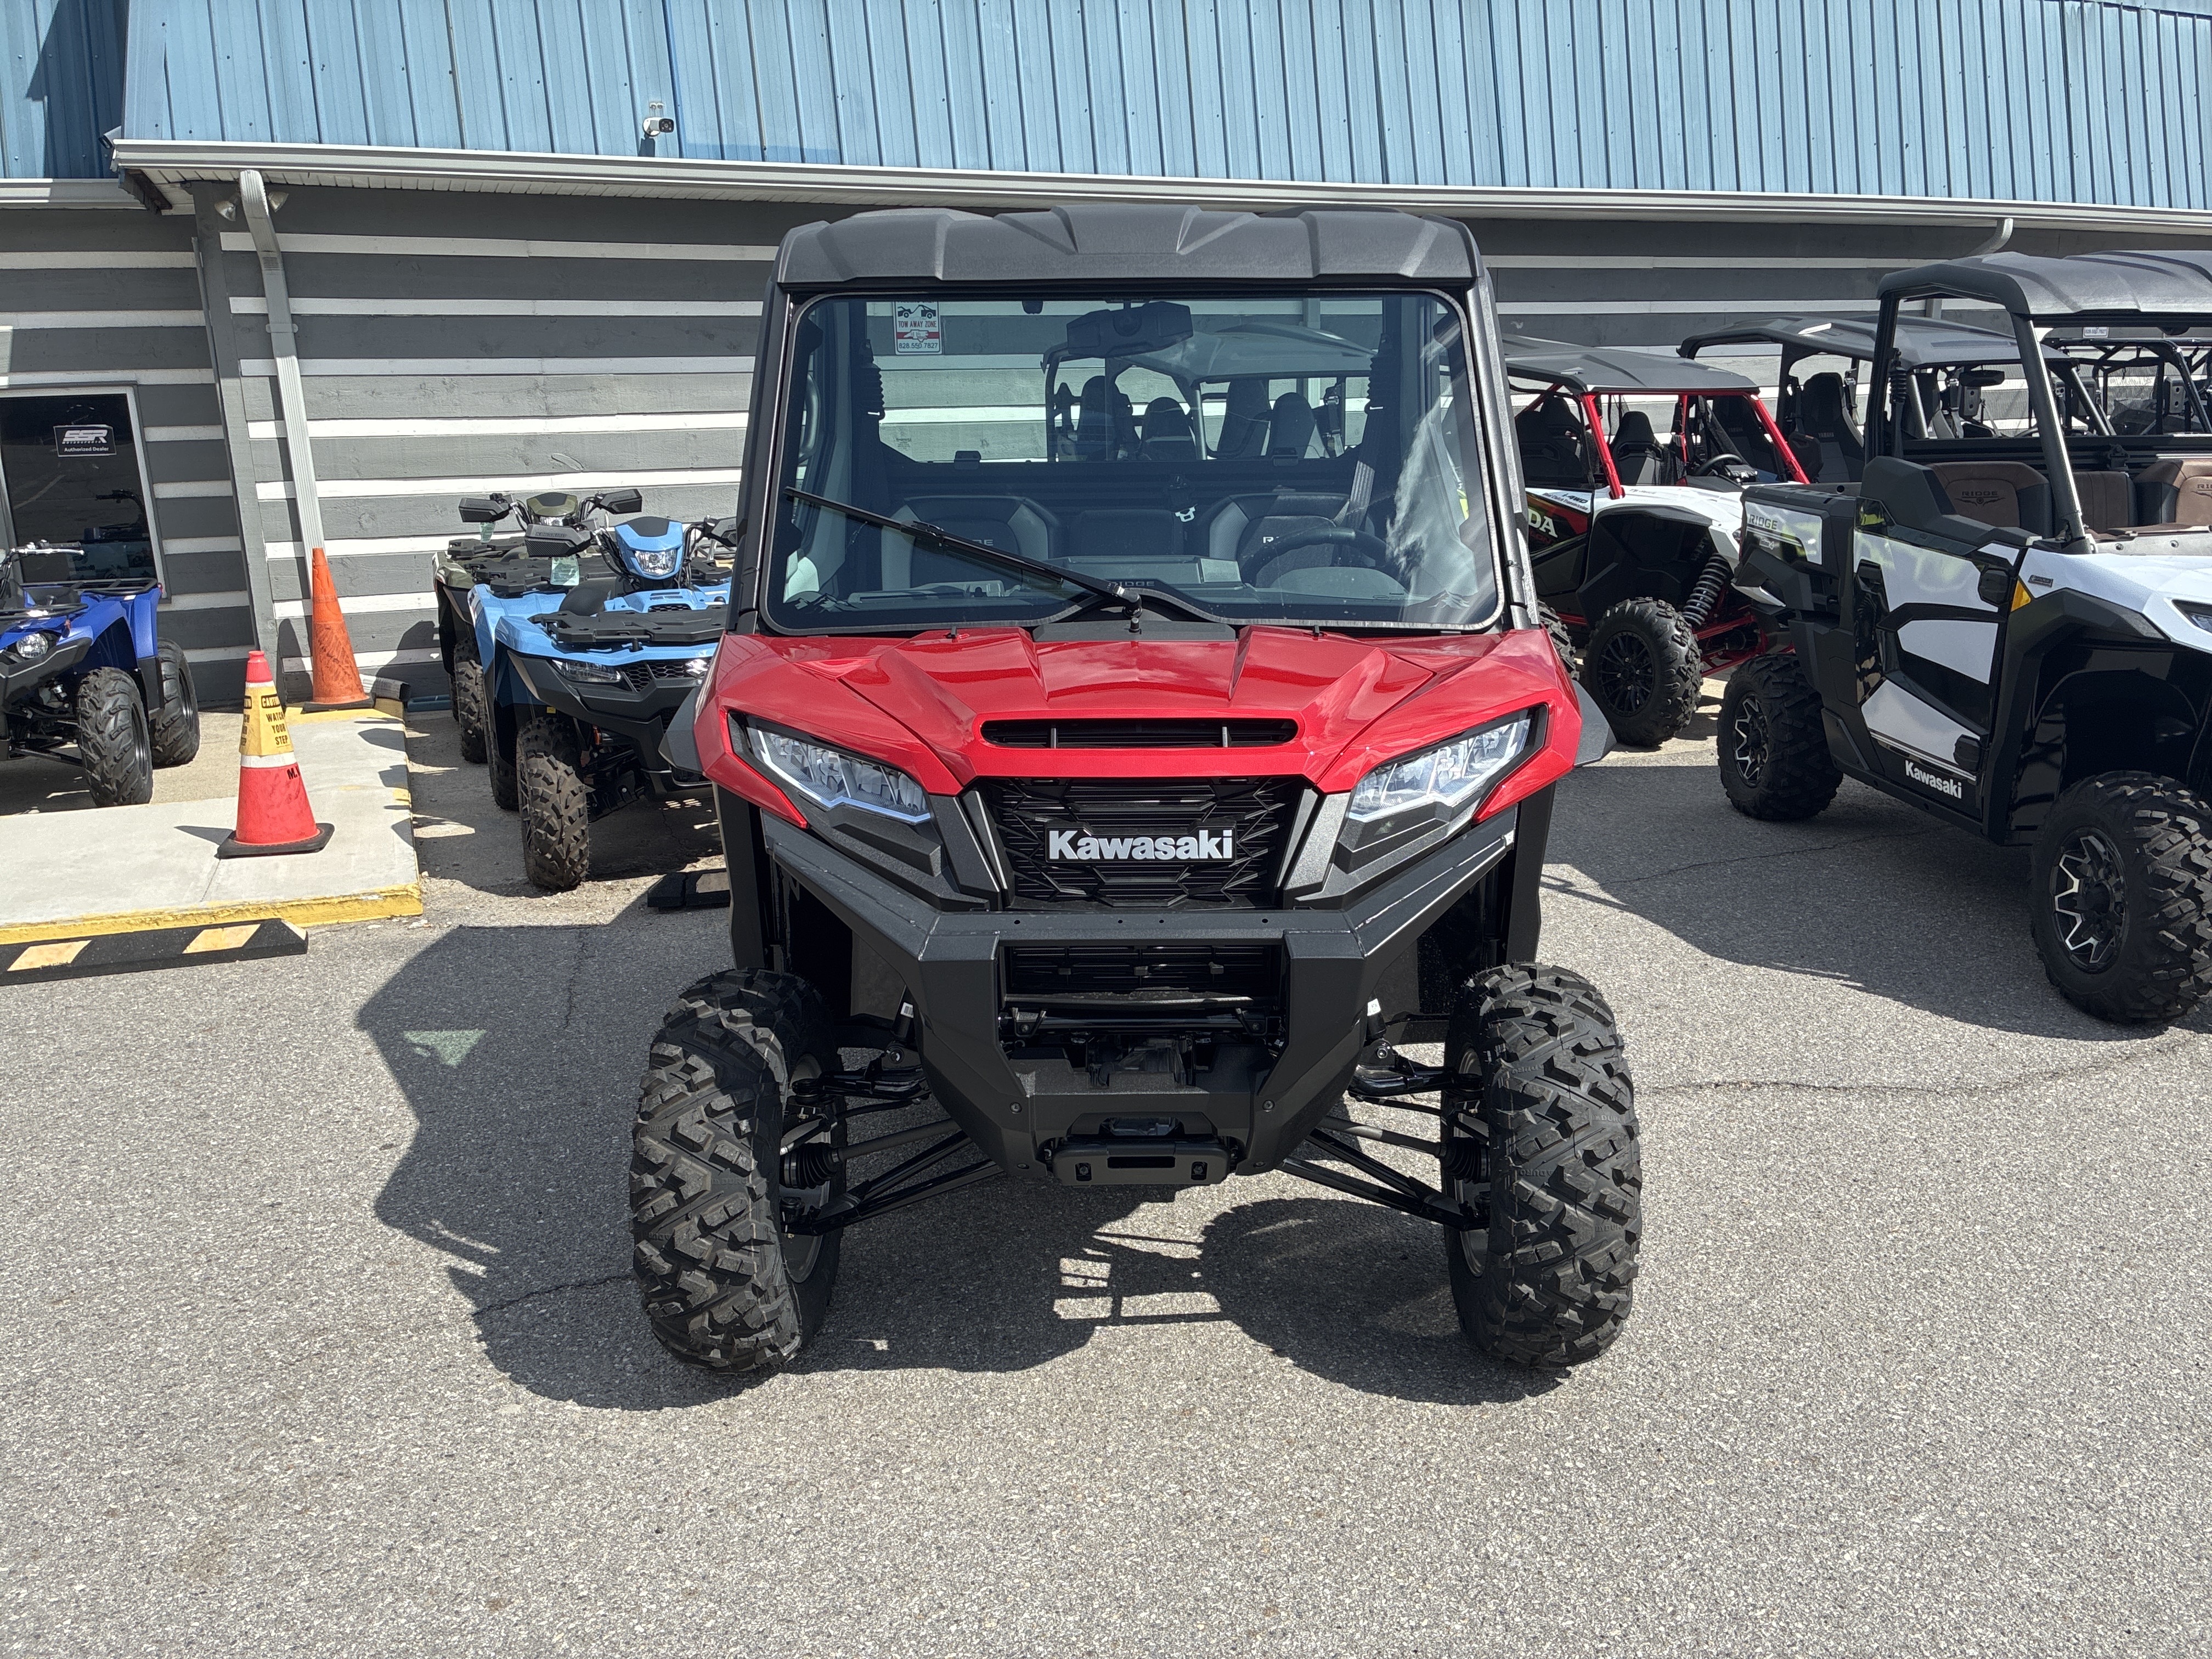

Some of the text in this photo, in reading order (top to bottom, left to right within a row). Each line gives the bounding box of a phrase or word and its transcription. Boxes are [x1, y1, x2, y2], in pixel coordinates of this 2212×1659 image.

[63, 430, 108, 443] SSR
[1749, 514, 1778, 530] RIDGE
[272, 723, 286, 734] YOUR
[275, 735, 288, 746] STEP
[1905, 759, 1962, 799] Kawasaki
[1048, 829, 1233, 860] Kawasaki
